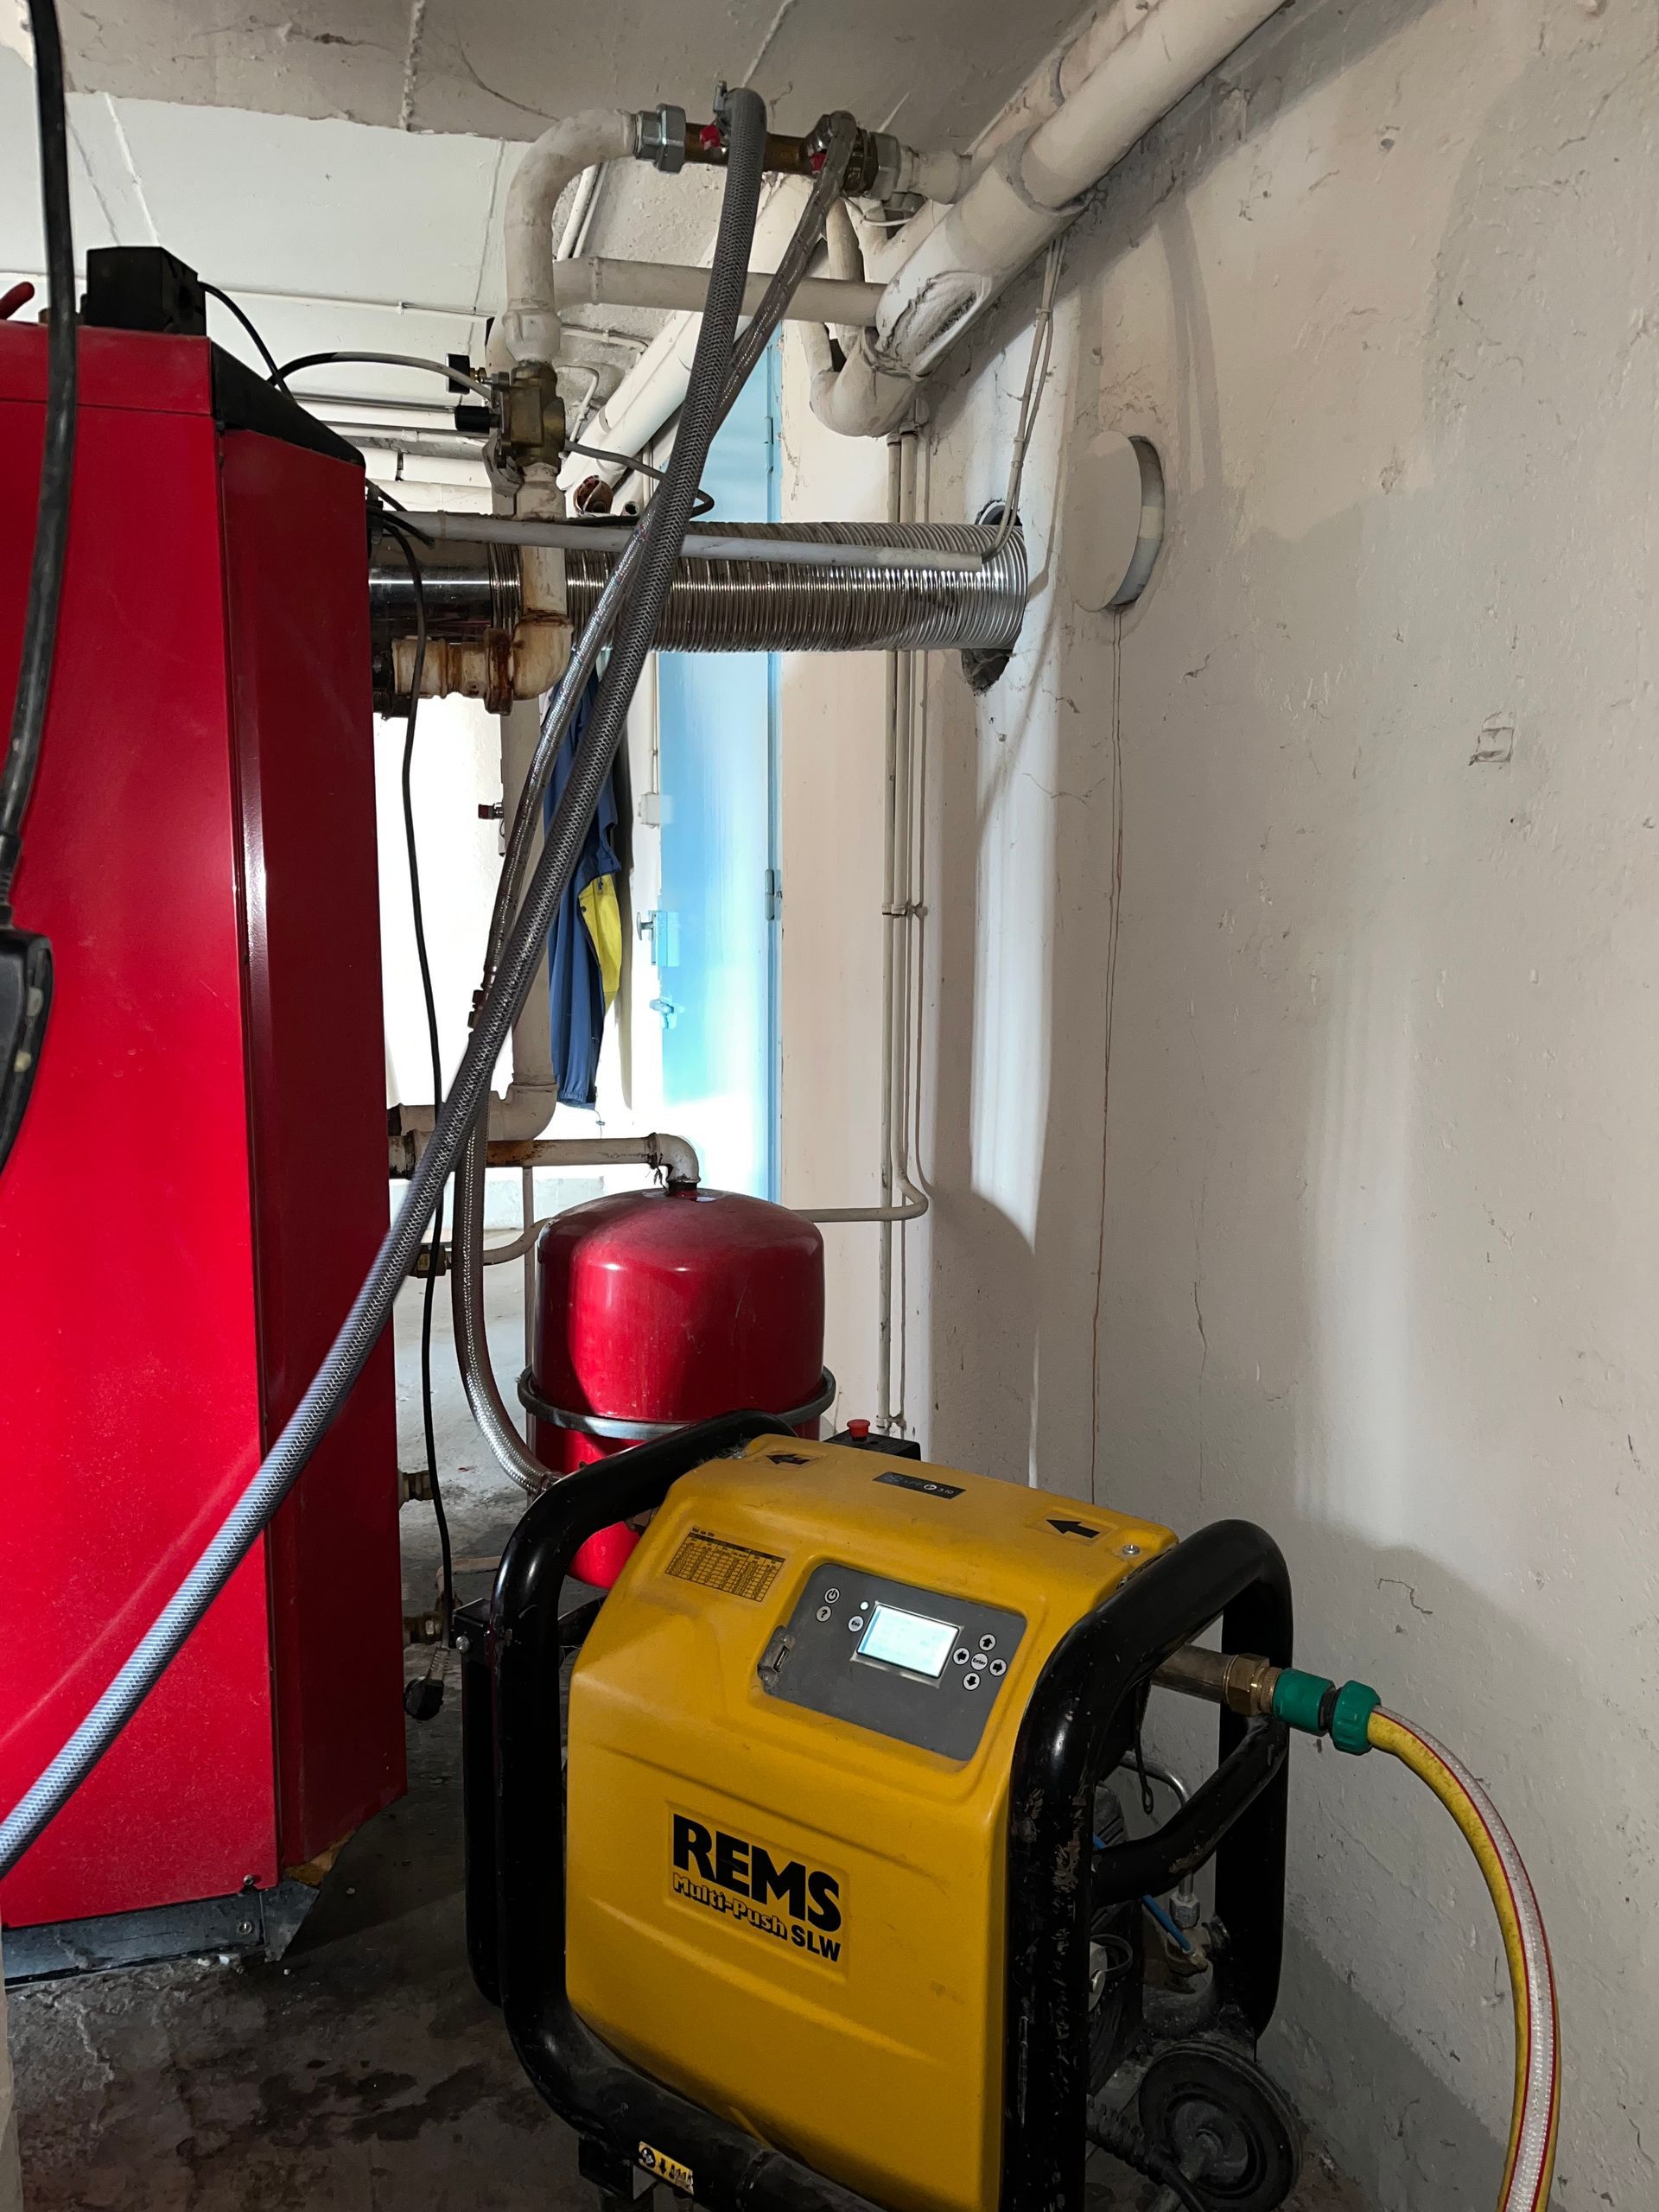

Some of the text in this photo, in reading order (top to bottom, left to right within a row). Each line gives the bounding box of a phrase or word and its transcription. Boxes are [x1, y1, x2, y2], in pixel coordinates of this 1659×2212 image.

[672, 1872, 841, 1962] Multi-Push SLW
[673, 1813, 842, 1932] REMS
